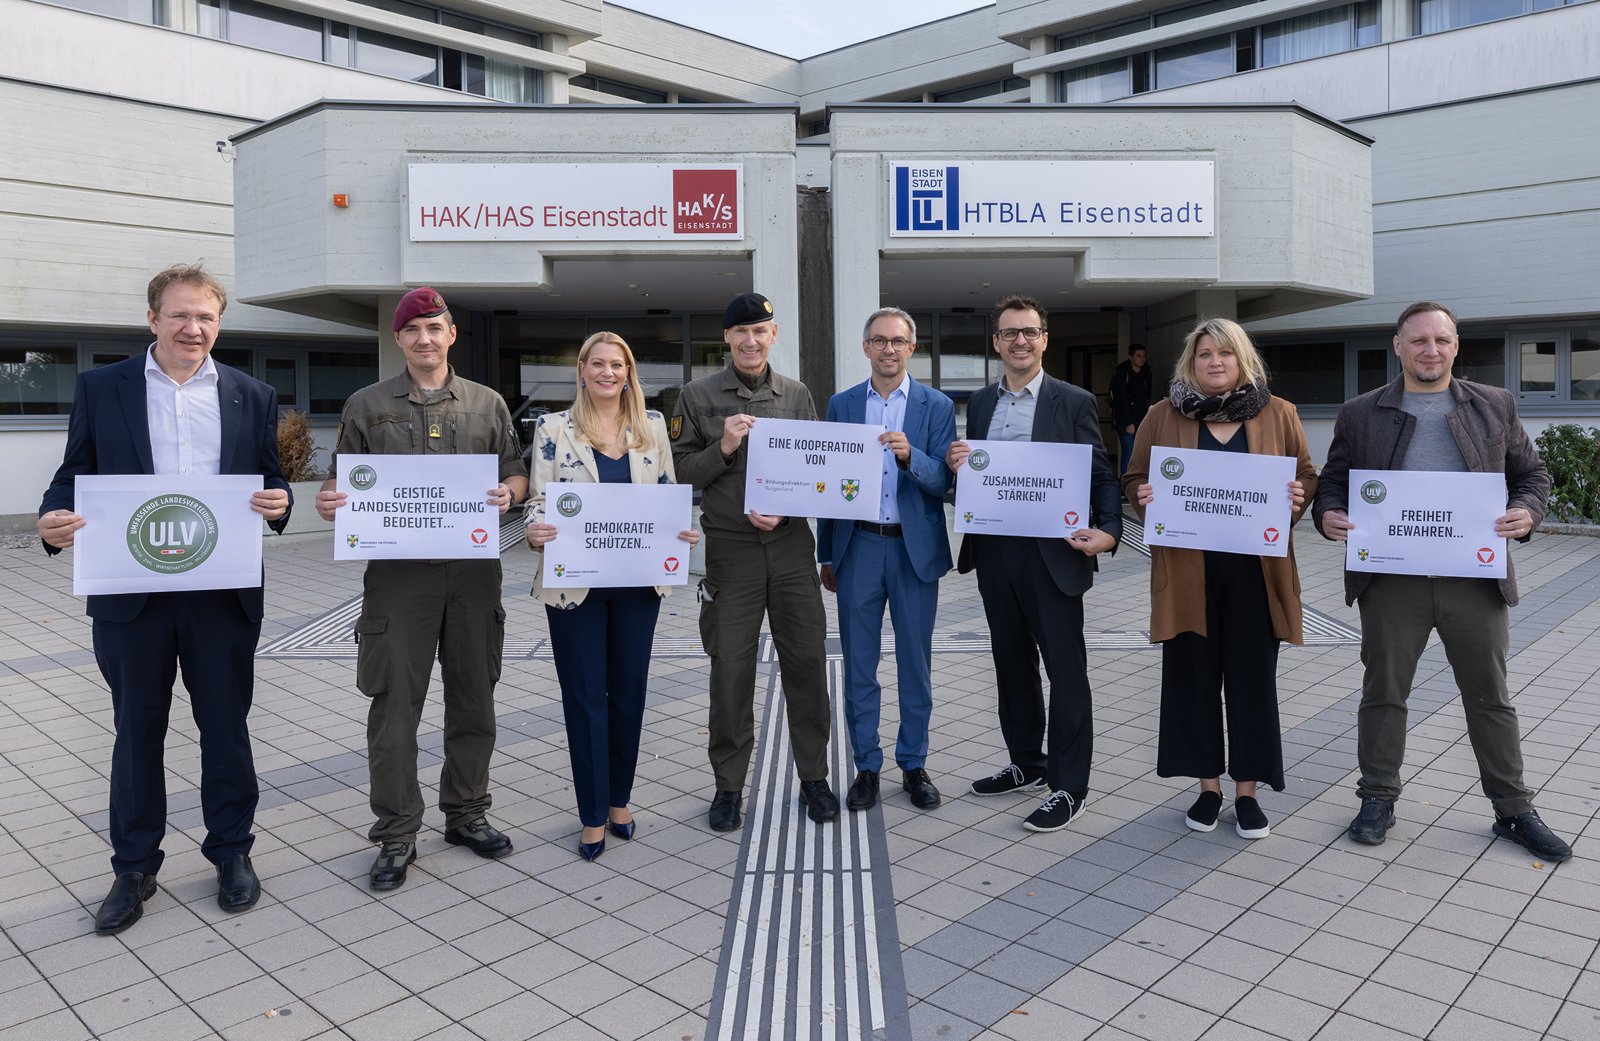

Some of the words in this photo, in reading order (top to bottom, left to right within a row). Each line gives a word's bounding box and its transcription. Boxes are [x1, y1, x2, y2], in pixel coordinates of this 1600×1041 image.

[912, 169, 944, 178] EISEN
[912, 179, 944, 188] STADT
[421, 203, 534, 229] HAK/HAS
[543, 205, 668, 227] Eisenstadt
[965, 202, 1047, 223] HTBLA
[1060, 202, 1203, 223] Eisenstadt
[768, 437, 791, 450] EINE
[794, 439, 864, 454] KOOPERATION
[805, 454, 826, 465] VON
[972, 456, 985, 464] ULV
[1165, 464, 1179, 473] ULV
[355, 473, 371, 482] ULV
[982, 475, 1064, 489] ZUSAMMENHALT
[393, 487, 445, 498] GEISTIGE
[997, 488, 1046, 502] STÄRKEN!
[1173, 484, 1268, 504] DESINFORMATION
[1366, 487, 1381, 497] ULV
[351, 501, 485, 513] LANDESVERTEIDIGUNG
[562, 500, 577, 509] ULV
[1184, 500, 1252, 518] ERKENNEN...
[130, 500, 159, 535] UMFASSENDE
[160, 496, 216, 535] LANDESVERTEIDIGUNG
[1401, 510, 1453, 522] FREIHEIT
[383, 516, 454, 528] BEDEUTET...
[584, 522, 654, 534] DEMOKRATIE
[149, 521, 198, 547] ULV
[1388, 525, 1464, 538] BEWAHREN...
[585, 535, 651, 549] SCHÜTZEN...
